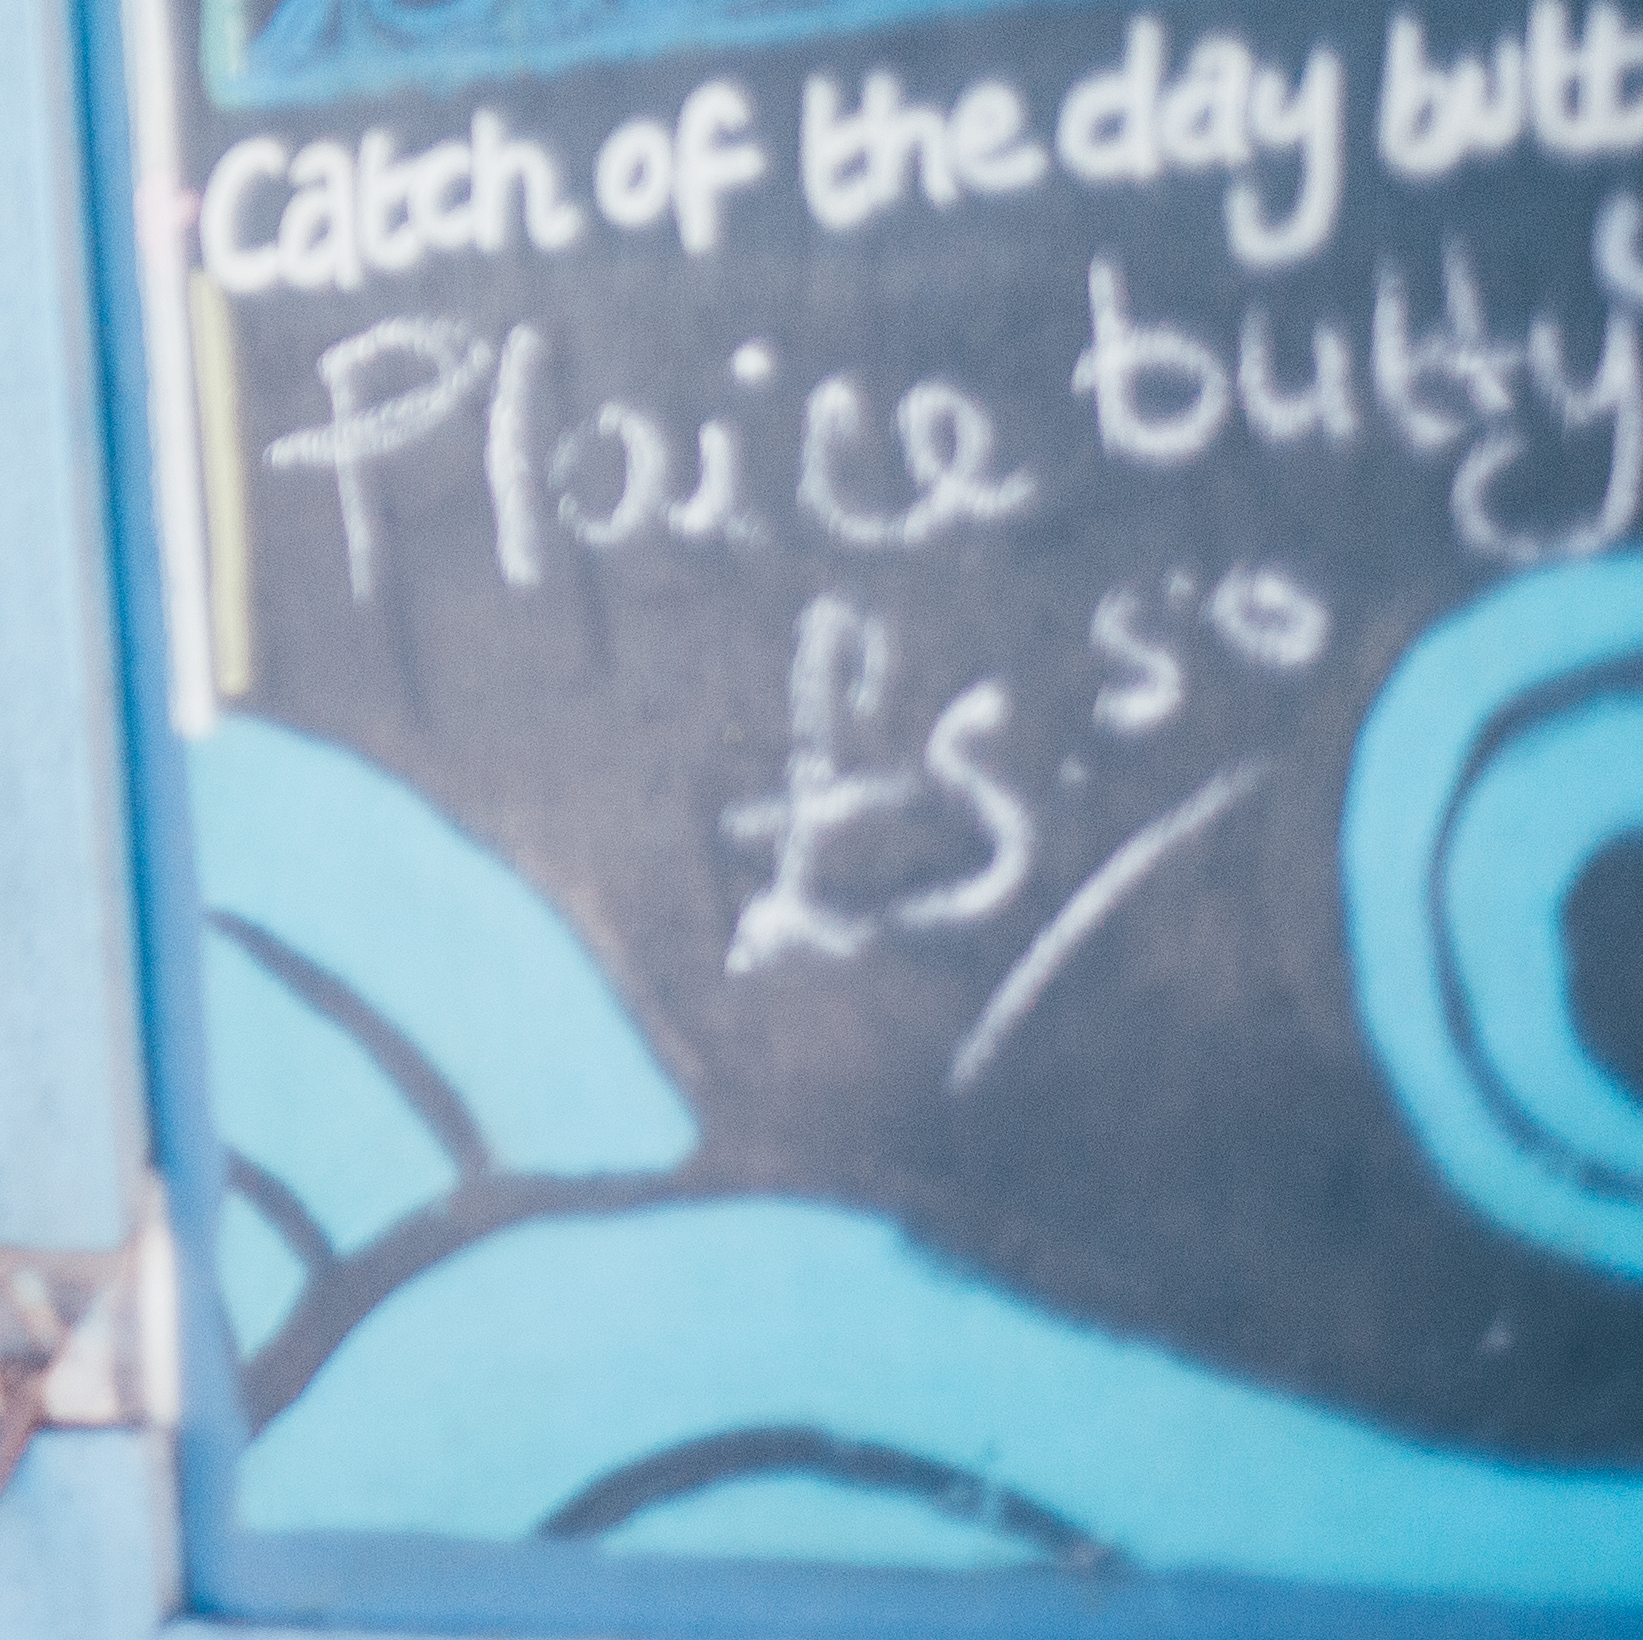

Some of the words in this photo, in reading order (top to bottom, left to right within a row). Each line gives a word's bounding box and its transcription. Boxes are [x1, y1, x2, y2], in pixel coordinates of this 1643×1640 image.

[595, 80, 765, 255] of
[800, 70, 1048, 230] the
[1054, 10, 1343, 268] day
[264, 316, 1038, 603] Plaice
[1071, 228, 1643, 563] butty
